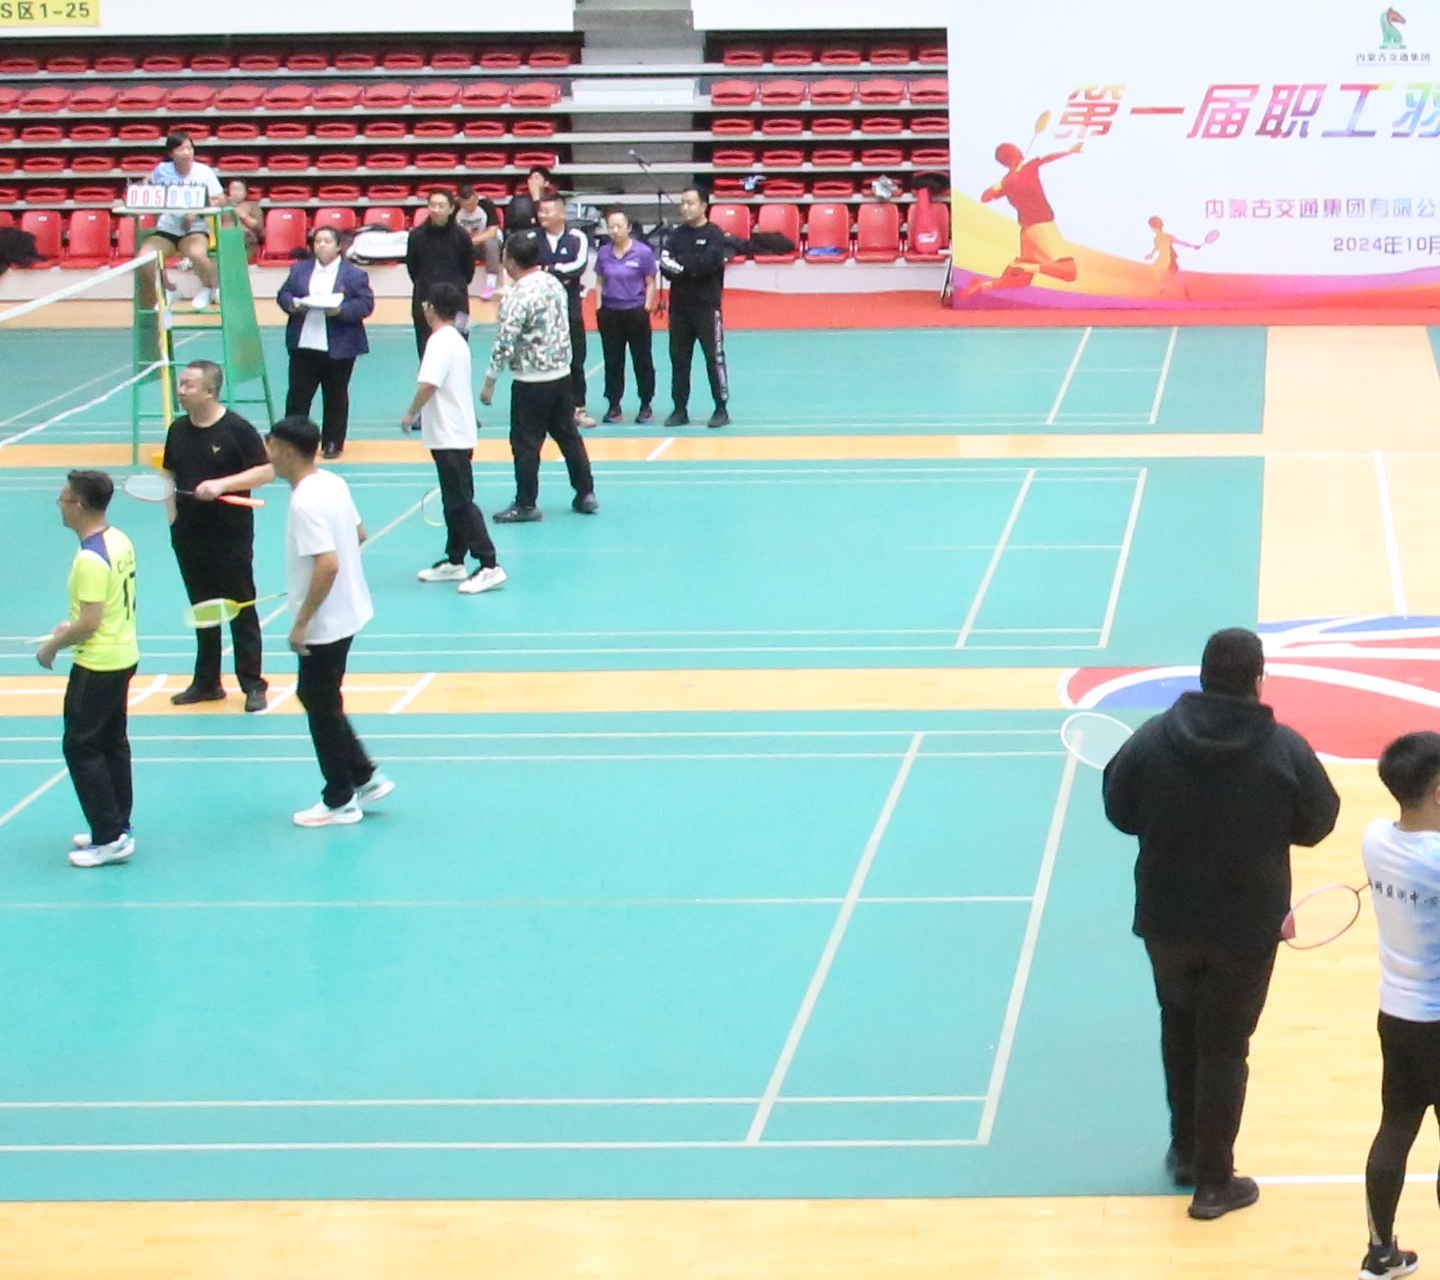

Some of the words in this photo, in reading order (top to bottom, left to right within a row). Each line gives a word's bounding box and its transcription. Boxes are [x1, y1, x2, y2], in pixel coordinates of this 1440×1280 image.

[0, 1, 90, 20] S区1-25
[1356, 52, 1431, 63] 内蒙古交通集团
